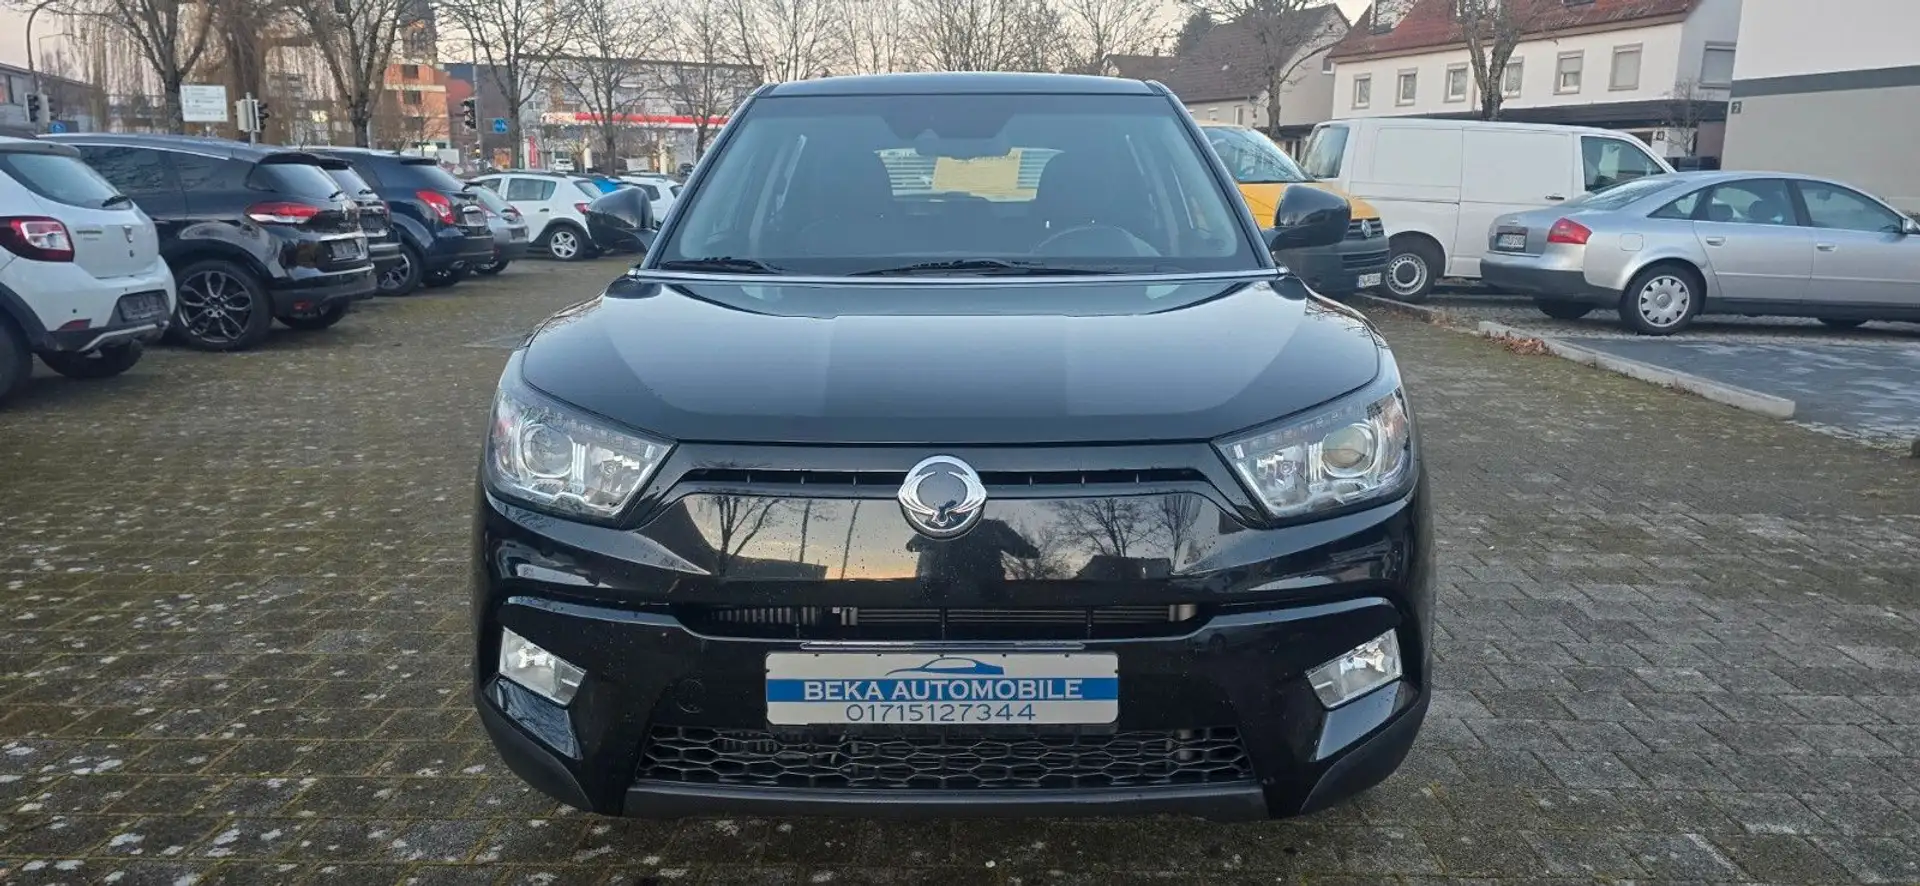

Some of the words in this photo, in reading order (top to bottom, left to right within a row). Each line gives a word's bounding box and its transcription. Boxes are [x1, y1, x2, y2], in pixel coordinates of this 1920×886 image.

[804, 680, 885, 700] BEKA
[892, 679, 1083, 700] AUTOMOBILE
[846, 703, 1037, 722] 01715127344
